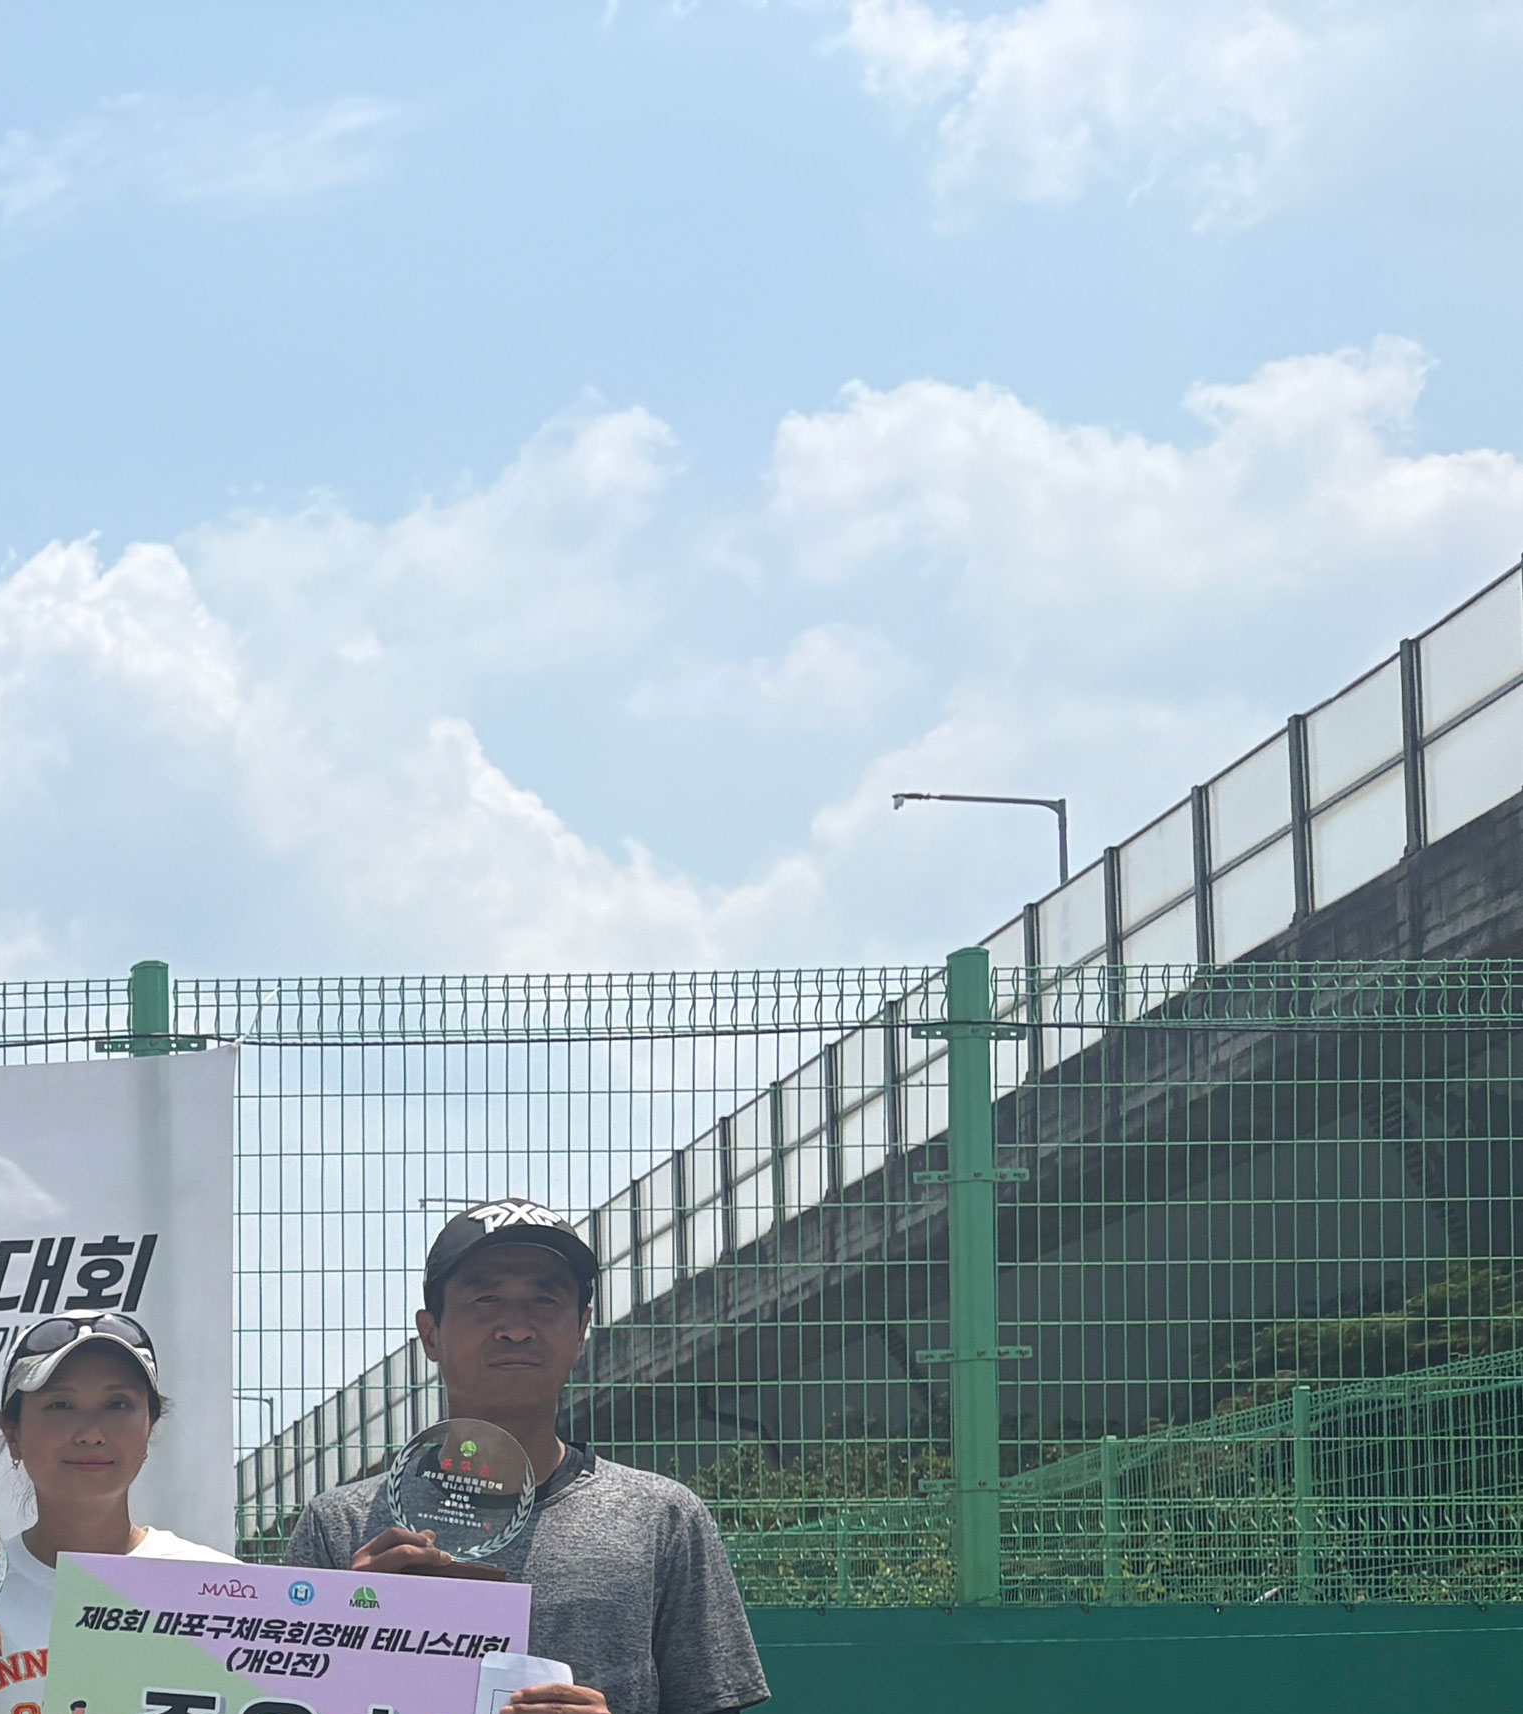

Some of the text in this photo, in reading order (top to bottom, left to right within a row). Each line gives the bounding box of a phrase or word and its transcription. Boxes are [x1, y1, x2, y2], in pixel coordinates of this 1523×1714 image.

[74, 1605, 510, 1660] 제8회 마포구체육회장배 테니스대회
[225, 1646, 331, 1679] (개인전)
